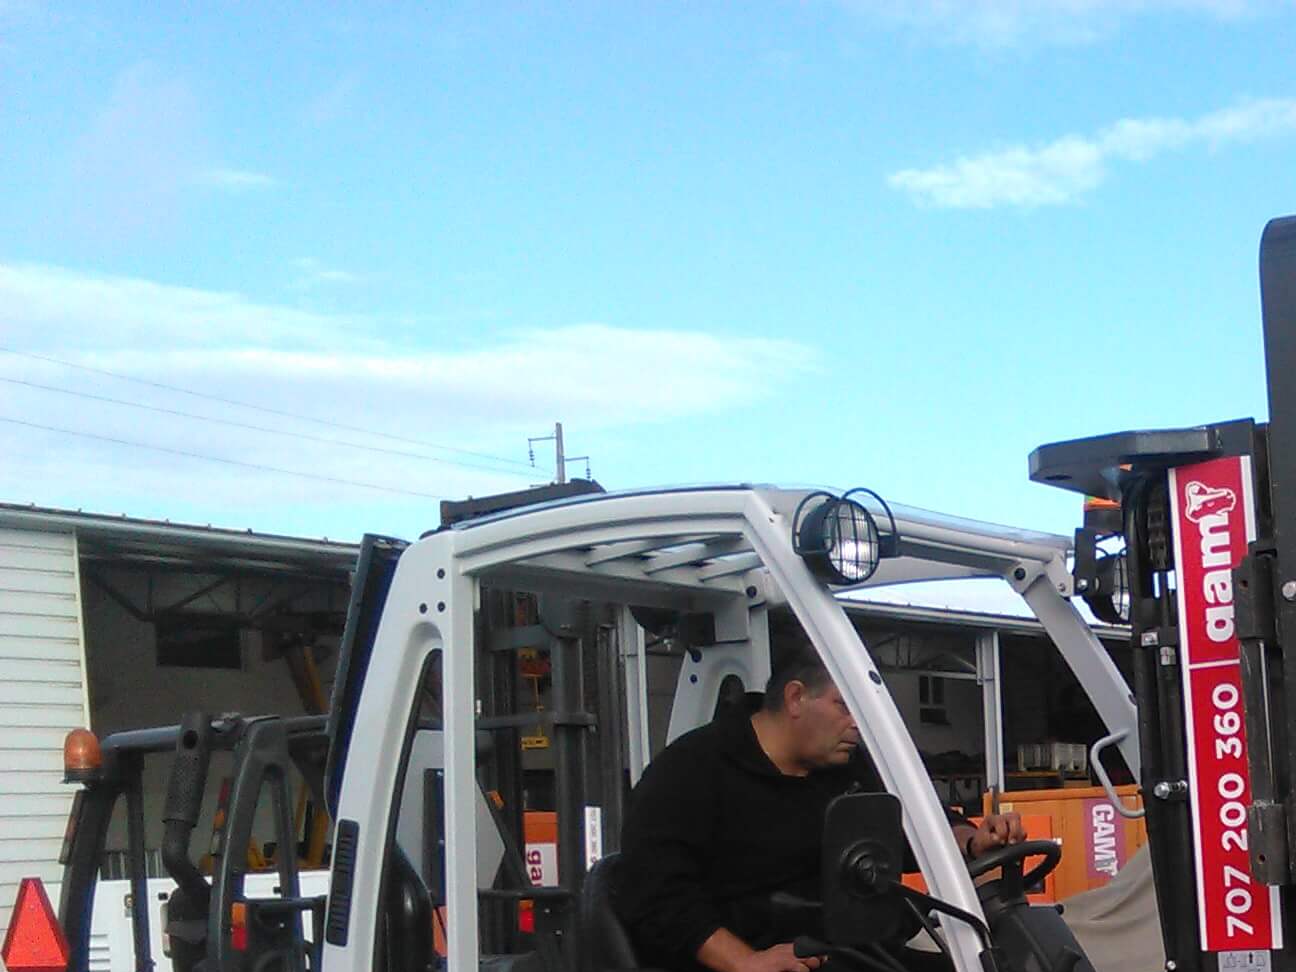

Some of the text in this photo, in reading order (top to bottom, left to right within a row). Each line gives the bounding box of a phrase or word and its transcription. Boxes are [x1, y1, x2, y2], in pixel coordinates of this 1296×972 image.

[527, 850, 543, 888] ga
[1212, 683, 1255, 938] 707 200 360
